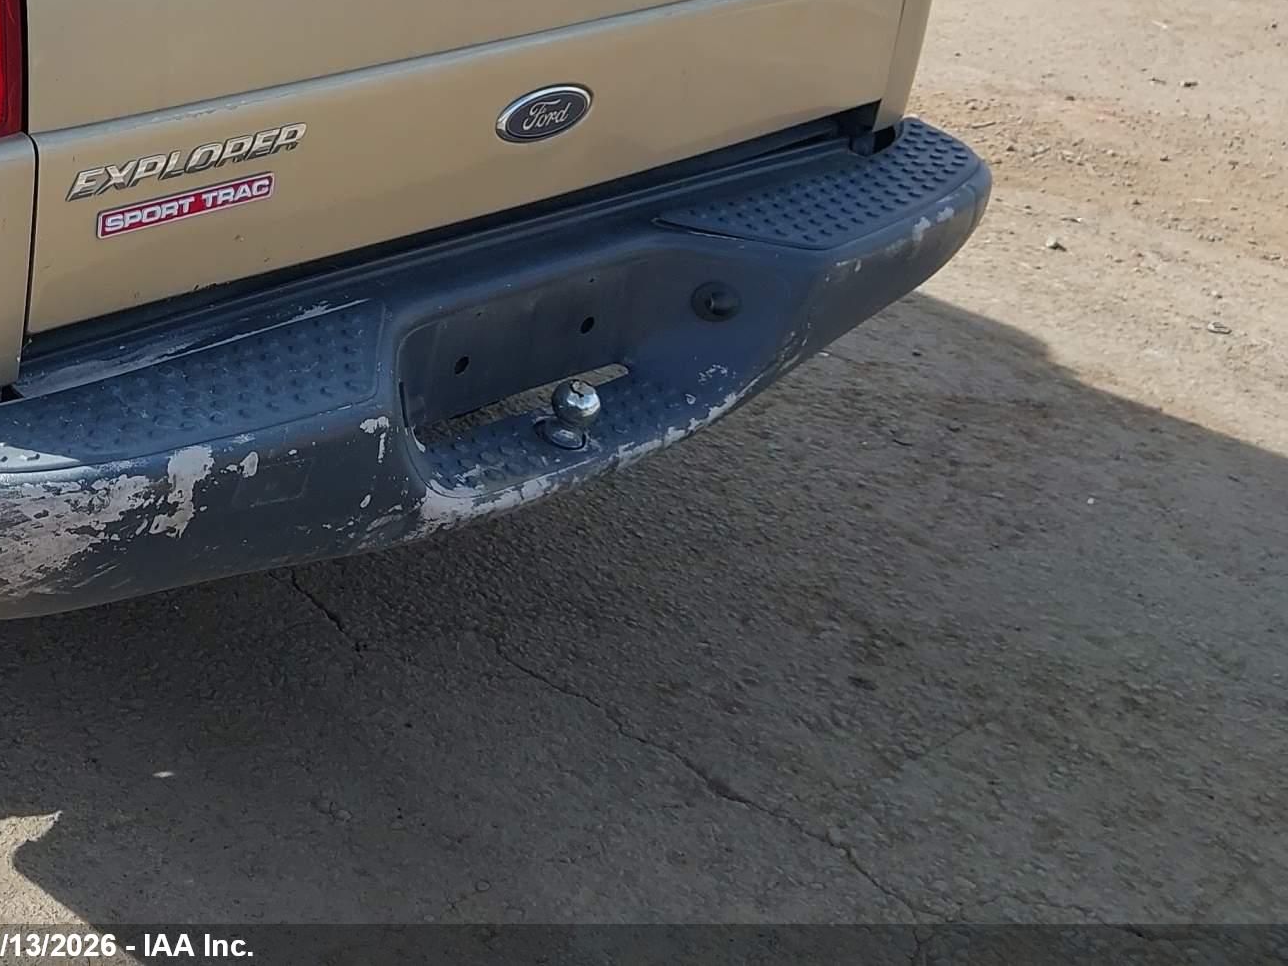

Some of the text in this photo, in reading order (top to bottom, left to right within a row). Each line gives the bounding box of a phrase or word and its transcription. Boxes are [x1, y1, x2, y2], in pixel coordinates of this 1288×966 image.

[523, 99, 572, 131] Ford
[66, 123, 307, 202] EXPLORER
[105, 179, 270, 232] SPORT TRAC
